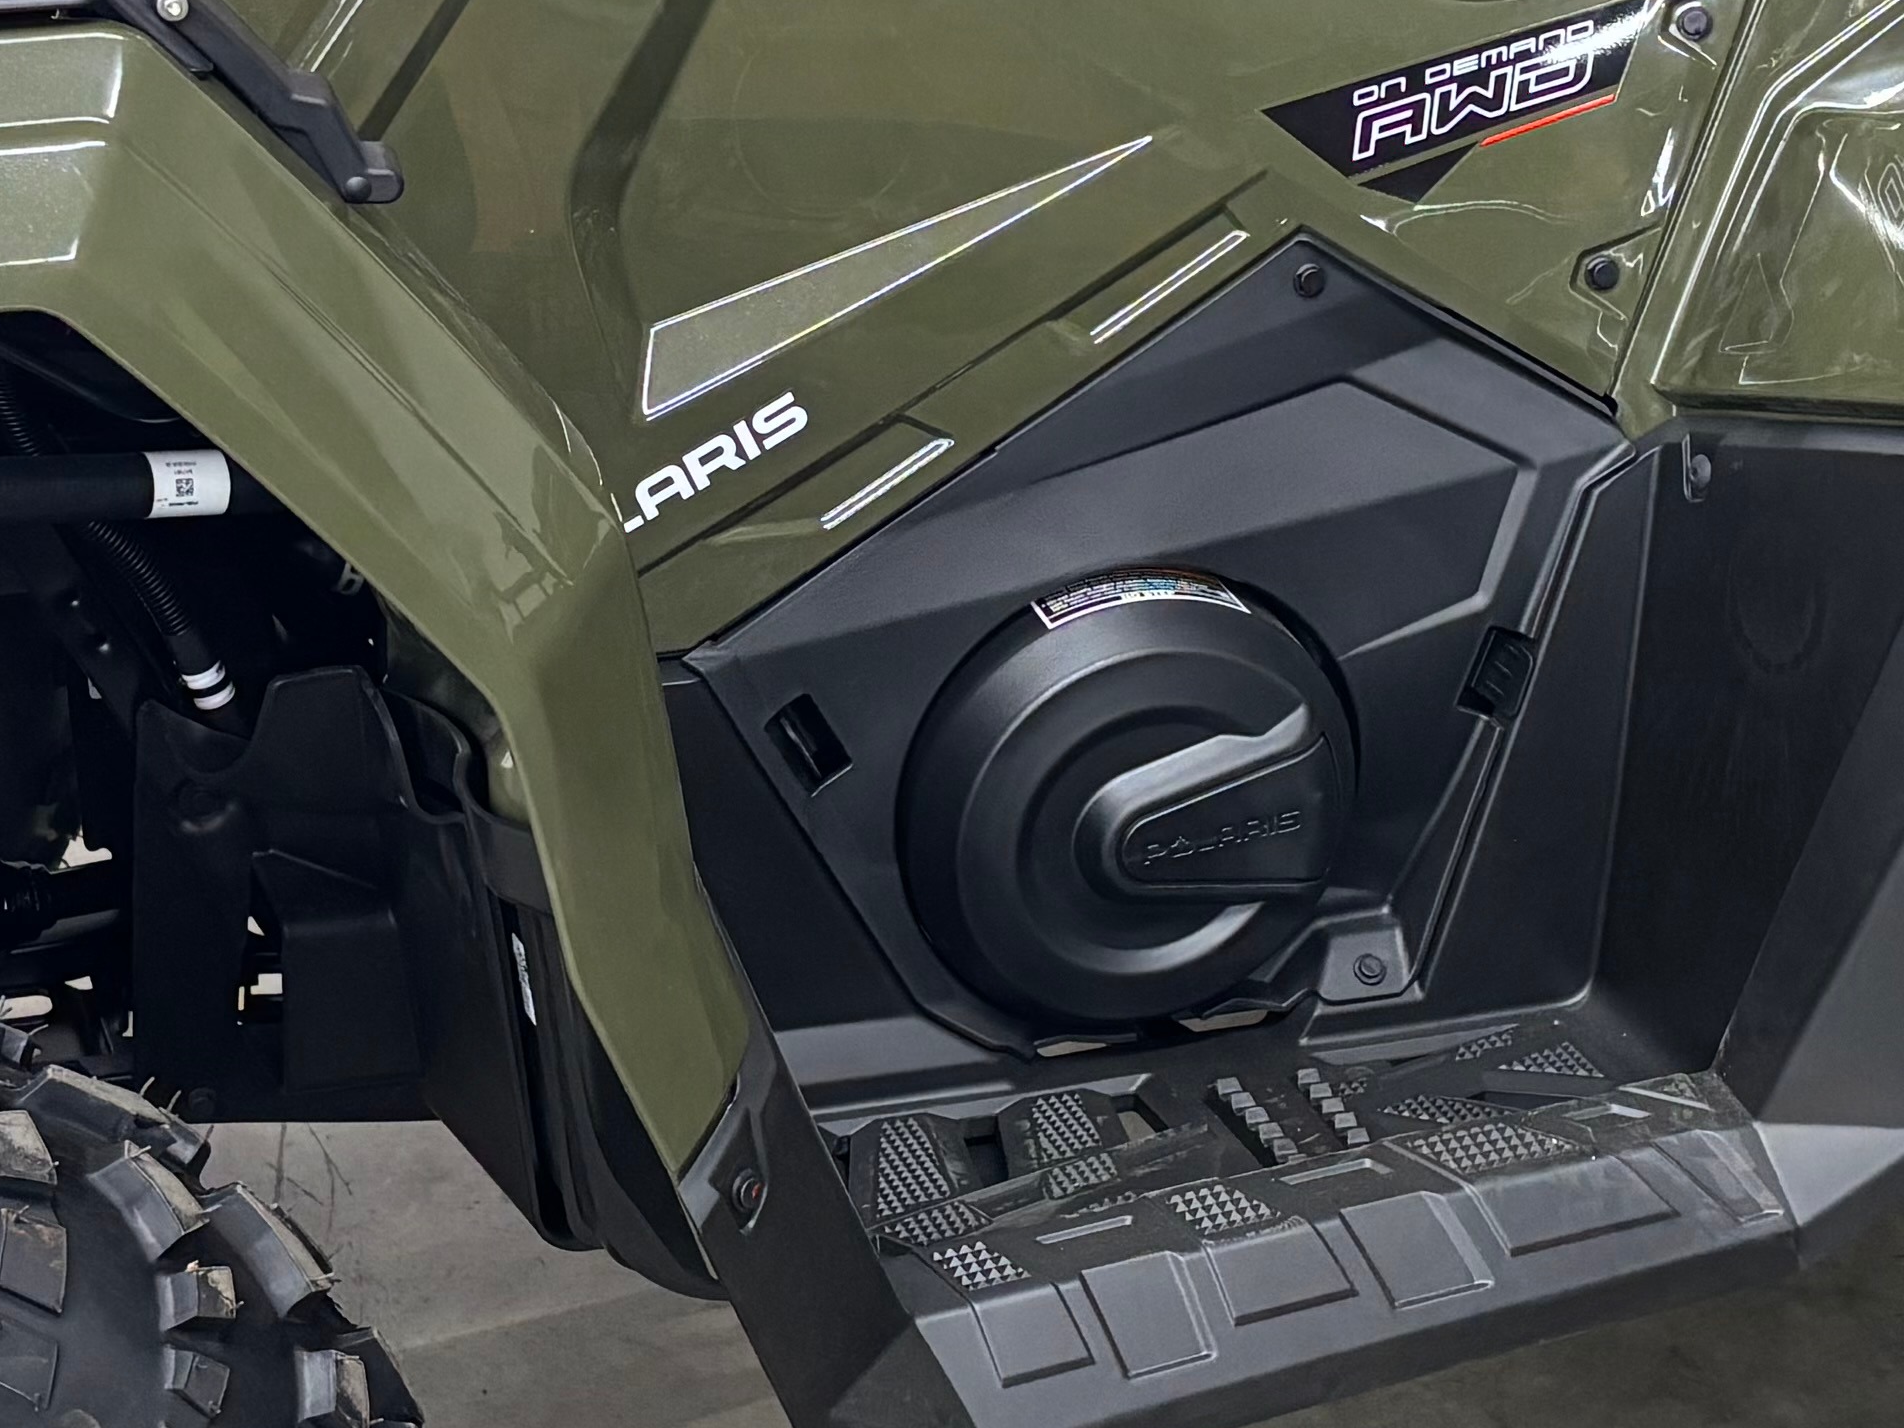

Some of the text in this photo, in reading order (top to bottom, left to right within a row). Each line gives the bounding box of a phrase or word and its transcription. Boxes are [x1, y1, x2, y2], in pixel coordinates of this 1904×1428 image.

[1351, 52, 1595, 162] AWD
[1352, 18, 1595, 107] ON DEMAND
[1144, 810, 1302, 866] POLARIS
